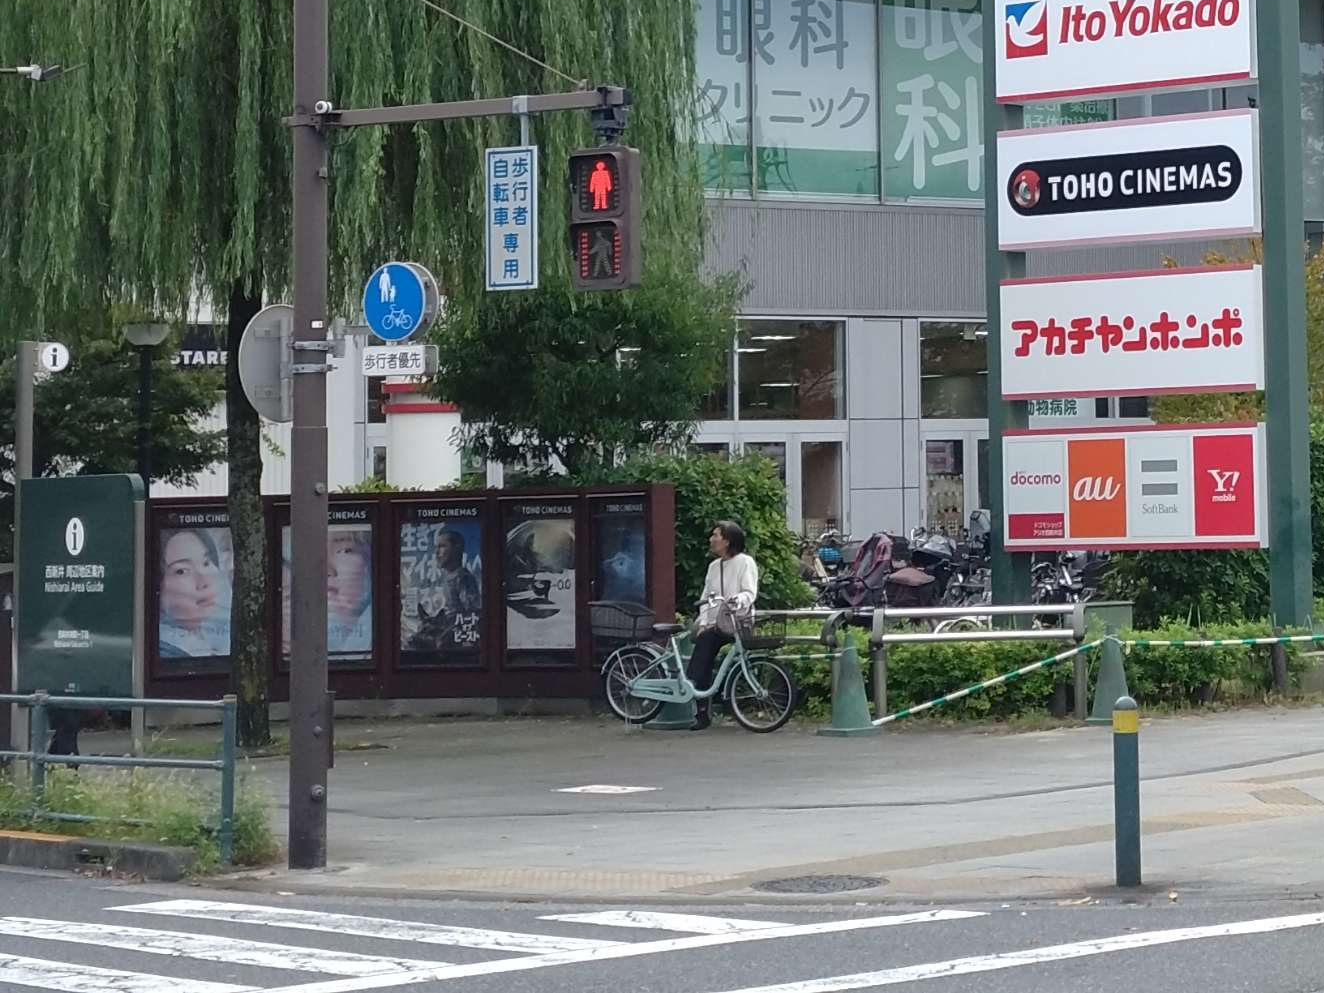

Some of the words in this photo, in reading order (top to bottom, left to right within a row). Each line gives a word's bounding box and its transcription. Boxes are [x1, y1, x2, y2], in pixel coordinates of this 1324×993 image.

[697, 78, 871, 129] クリニック
[1047, 171, 1113, 201] TOHO
[1119, 160, 1232, 196] CINEMAS
[1011, 308, 1243, 357] アカチャンホンポ
[364, 353, 421, 370] 歩行者優先
[1010, 471, 1061, 486] docomo
[1072, 476, 1122, 501] au
[1207, 469, 1241, 493] Y!
[1212, 494, 1236, 502] mobile
[440, 508, 477, 516] CINEMAS
[1142, 503, 1179, 514] SoftBank
